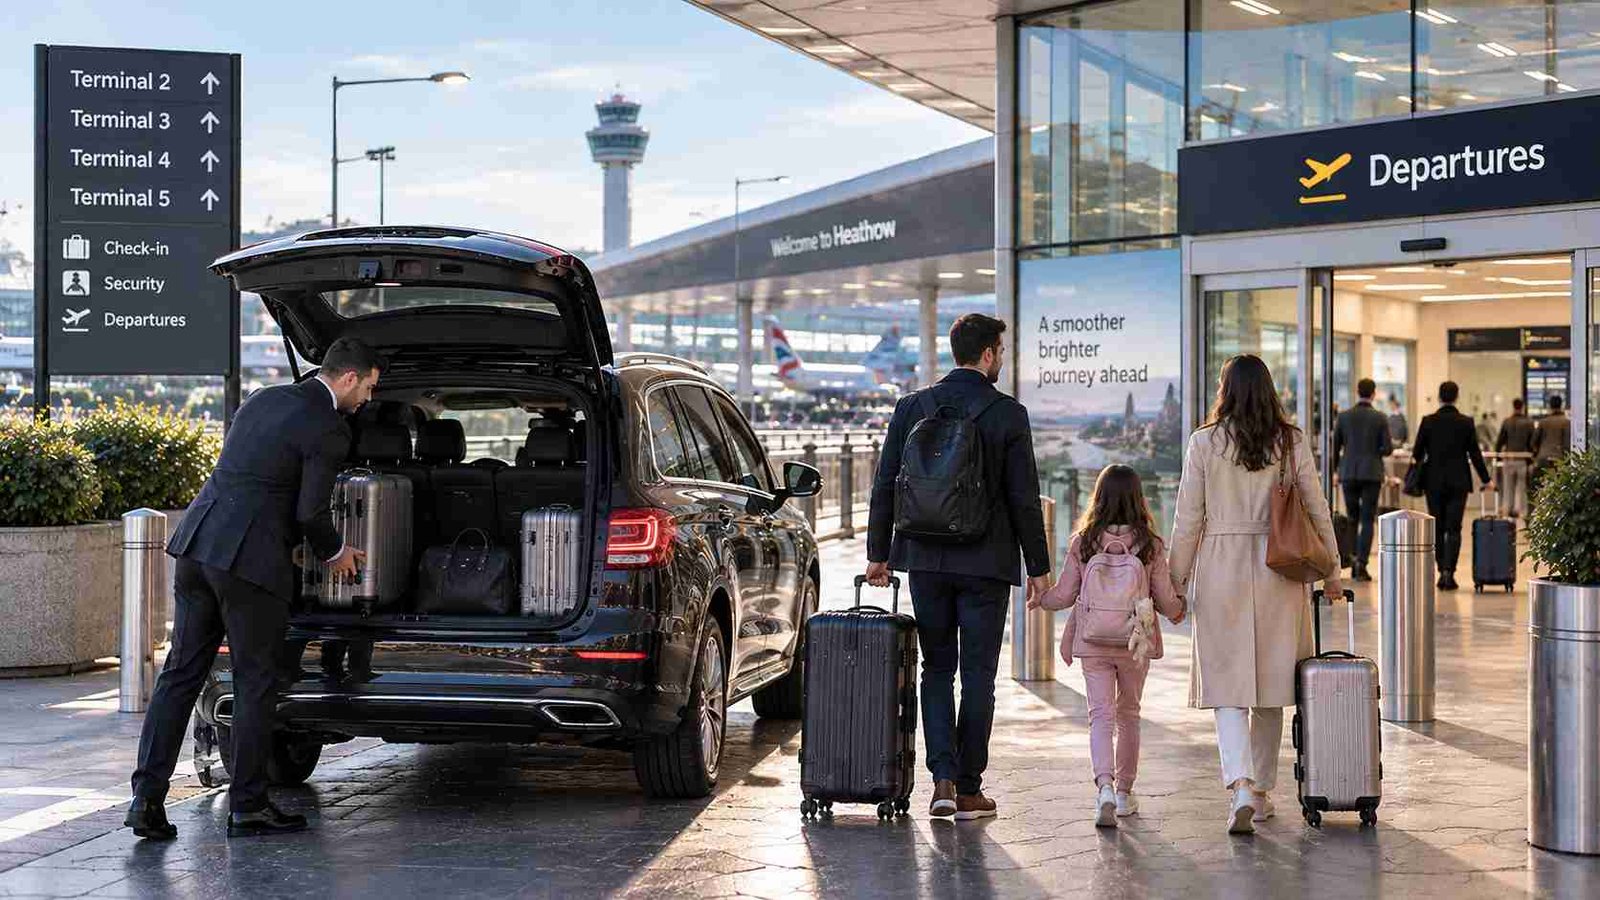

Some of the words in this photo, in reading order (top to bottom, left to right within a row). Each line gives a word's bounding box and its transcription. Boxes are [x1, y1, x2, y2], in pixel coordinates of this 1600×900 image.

[70, 70, 153, 90] Terminal
[158, 73, 171, 91] 2
[70, 109, 153, 129] Terminal
[158, 112, 171, 130] 3
[70, 148, 153, 168] Terminal
[158, 151, 171, 169] 4
[1369, 143, 1545, 192] Departures
[70, 188, 153, 207] Terminal
[158, 190, 171, 207] 5
[104, 240, 169, 256] Check-in
[771, 235, 819, 257] Welcome
[819, 230, 832, 249] to
[104, 276, 165, 294] Security
[104, 312, 186, 330] Departures
[1038, 315, 1050, 332] A
[1052, 312, 1126, 333] smoother
[1038, 339, 1101, 363] brighter
[1036, 366, 1096, 389] journey
[1099, 363, 1149, 384] ahead
